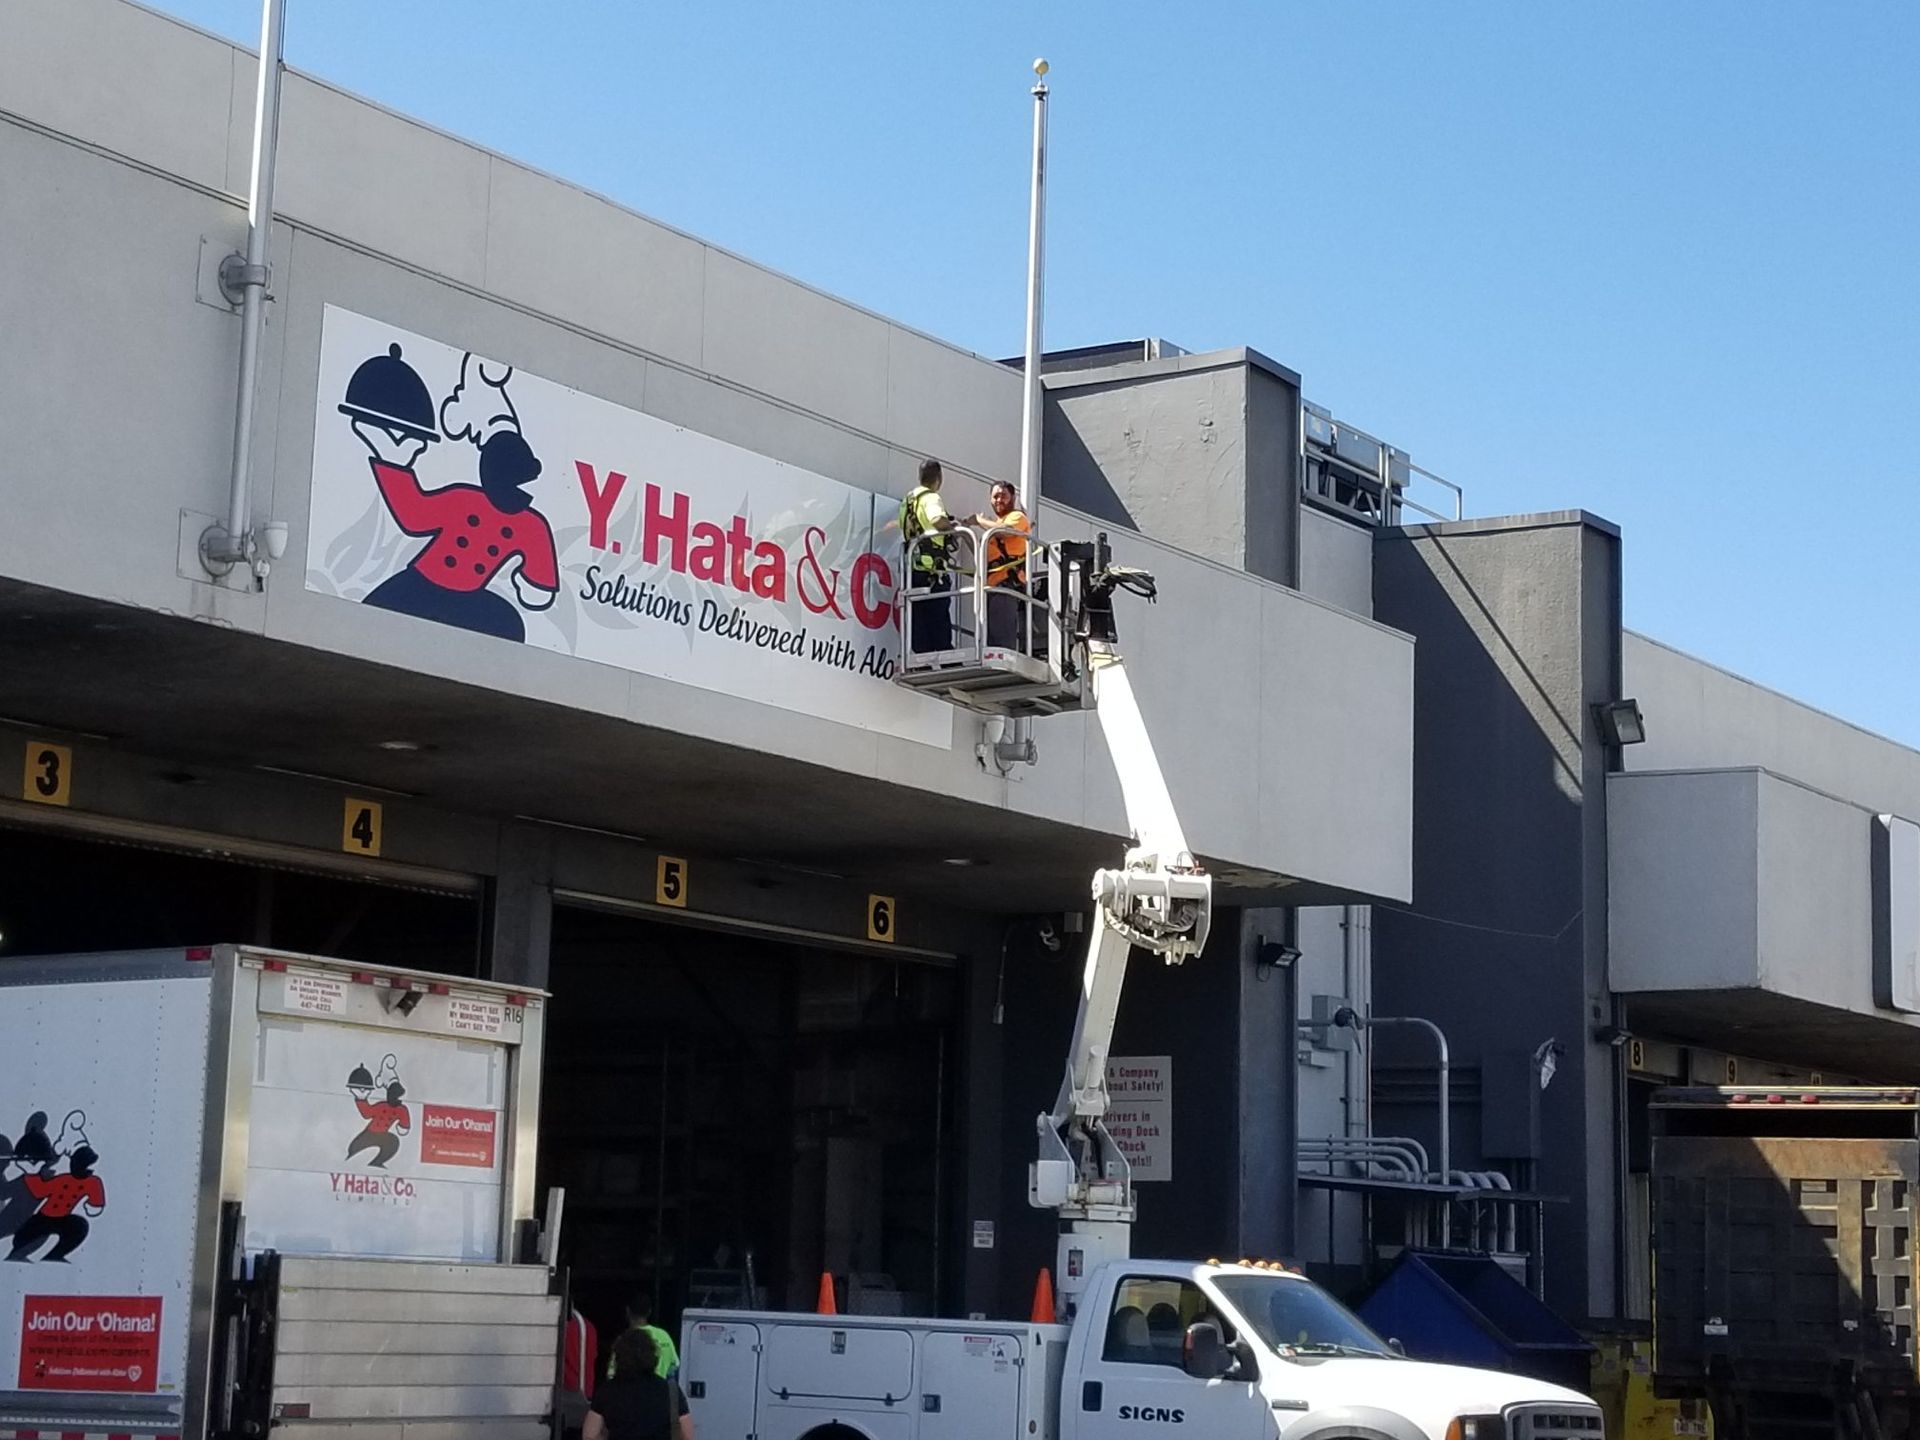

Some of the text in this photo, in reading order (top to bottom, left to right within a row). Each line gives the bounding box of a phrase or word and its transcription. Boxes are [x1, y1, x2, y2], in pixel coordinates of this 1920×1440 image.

[574, 459, 627, 554] Y.
[642, 482, 787, 603] Hata
[796, 526, 848, 621] &
[579, 565, 896, 681] Solutions Delivered with Alo
[36, 750, 60, 796] 3
[352, 808, 373, 848] 4
[663, 862, 681, 900] 5
[873, 901, 889, 935] 6
[504, 1007, 522, 1023] R16
[1633, 1042, 1641, 1066] 8
[1120, 1067, 1159, 1079] Company
[1728, 1060, 1736, 1082] 9
[1108, 1081, 1163, 1092] bout Safety!
[425, 1115, 444, 1128] Join
[445, 1116, 460, 1129] Our
[1141, 1111, 1151, 1121] in
[1136, 1125, 1160, 1136] Dock
[344, 1173, 379, 1194] Hata
[28, 1312, 61, 1330] Join
[64, 1312, 95, 1331] Our
[1118, 1405, 1185, 1423] SIGNS
